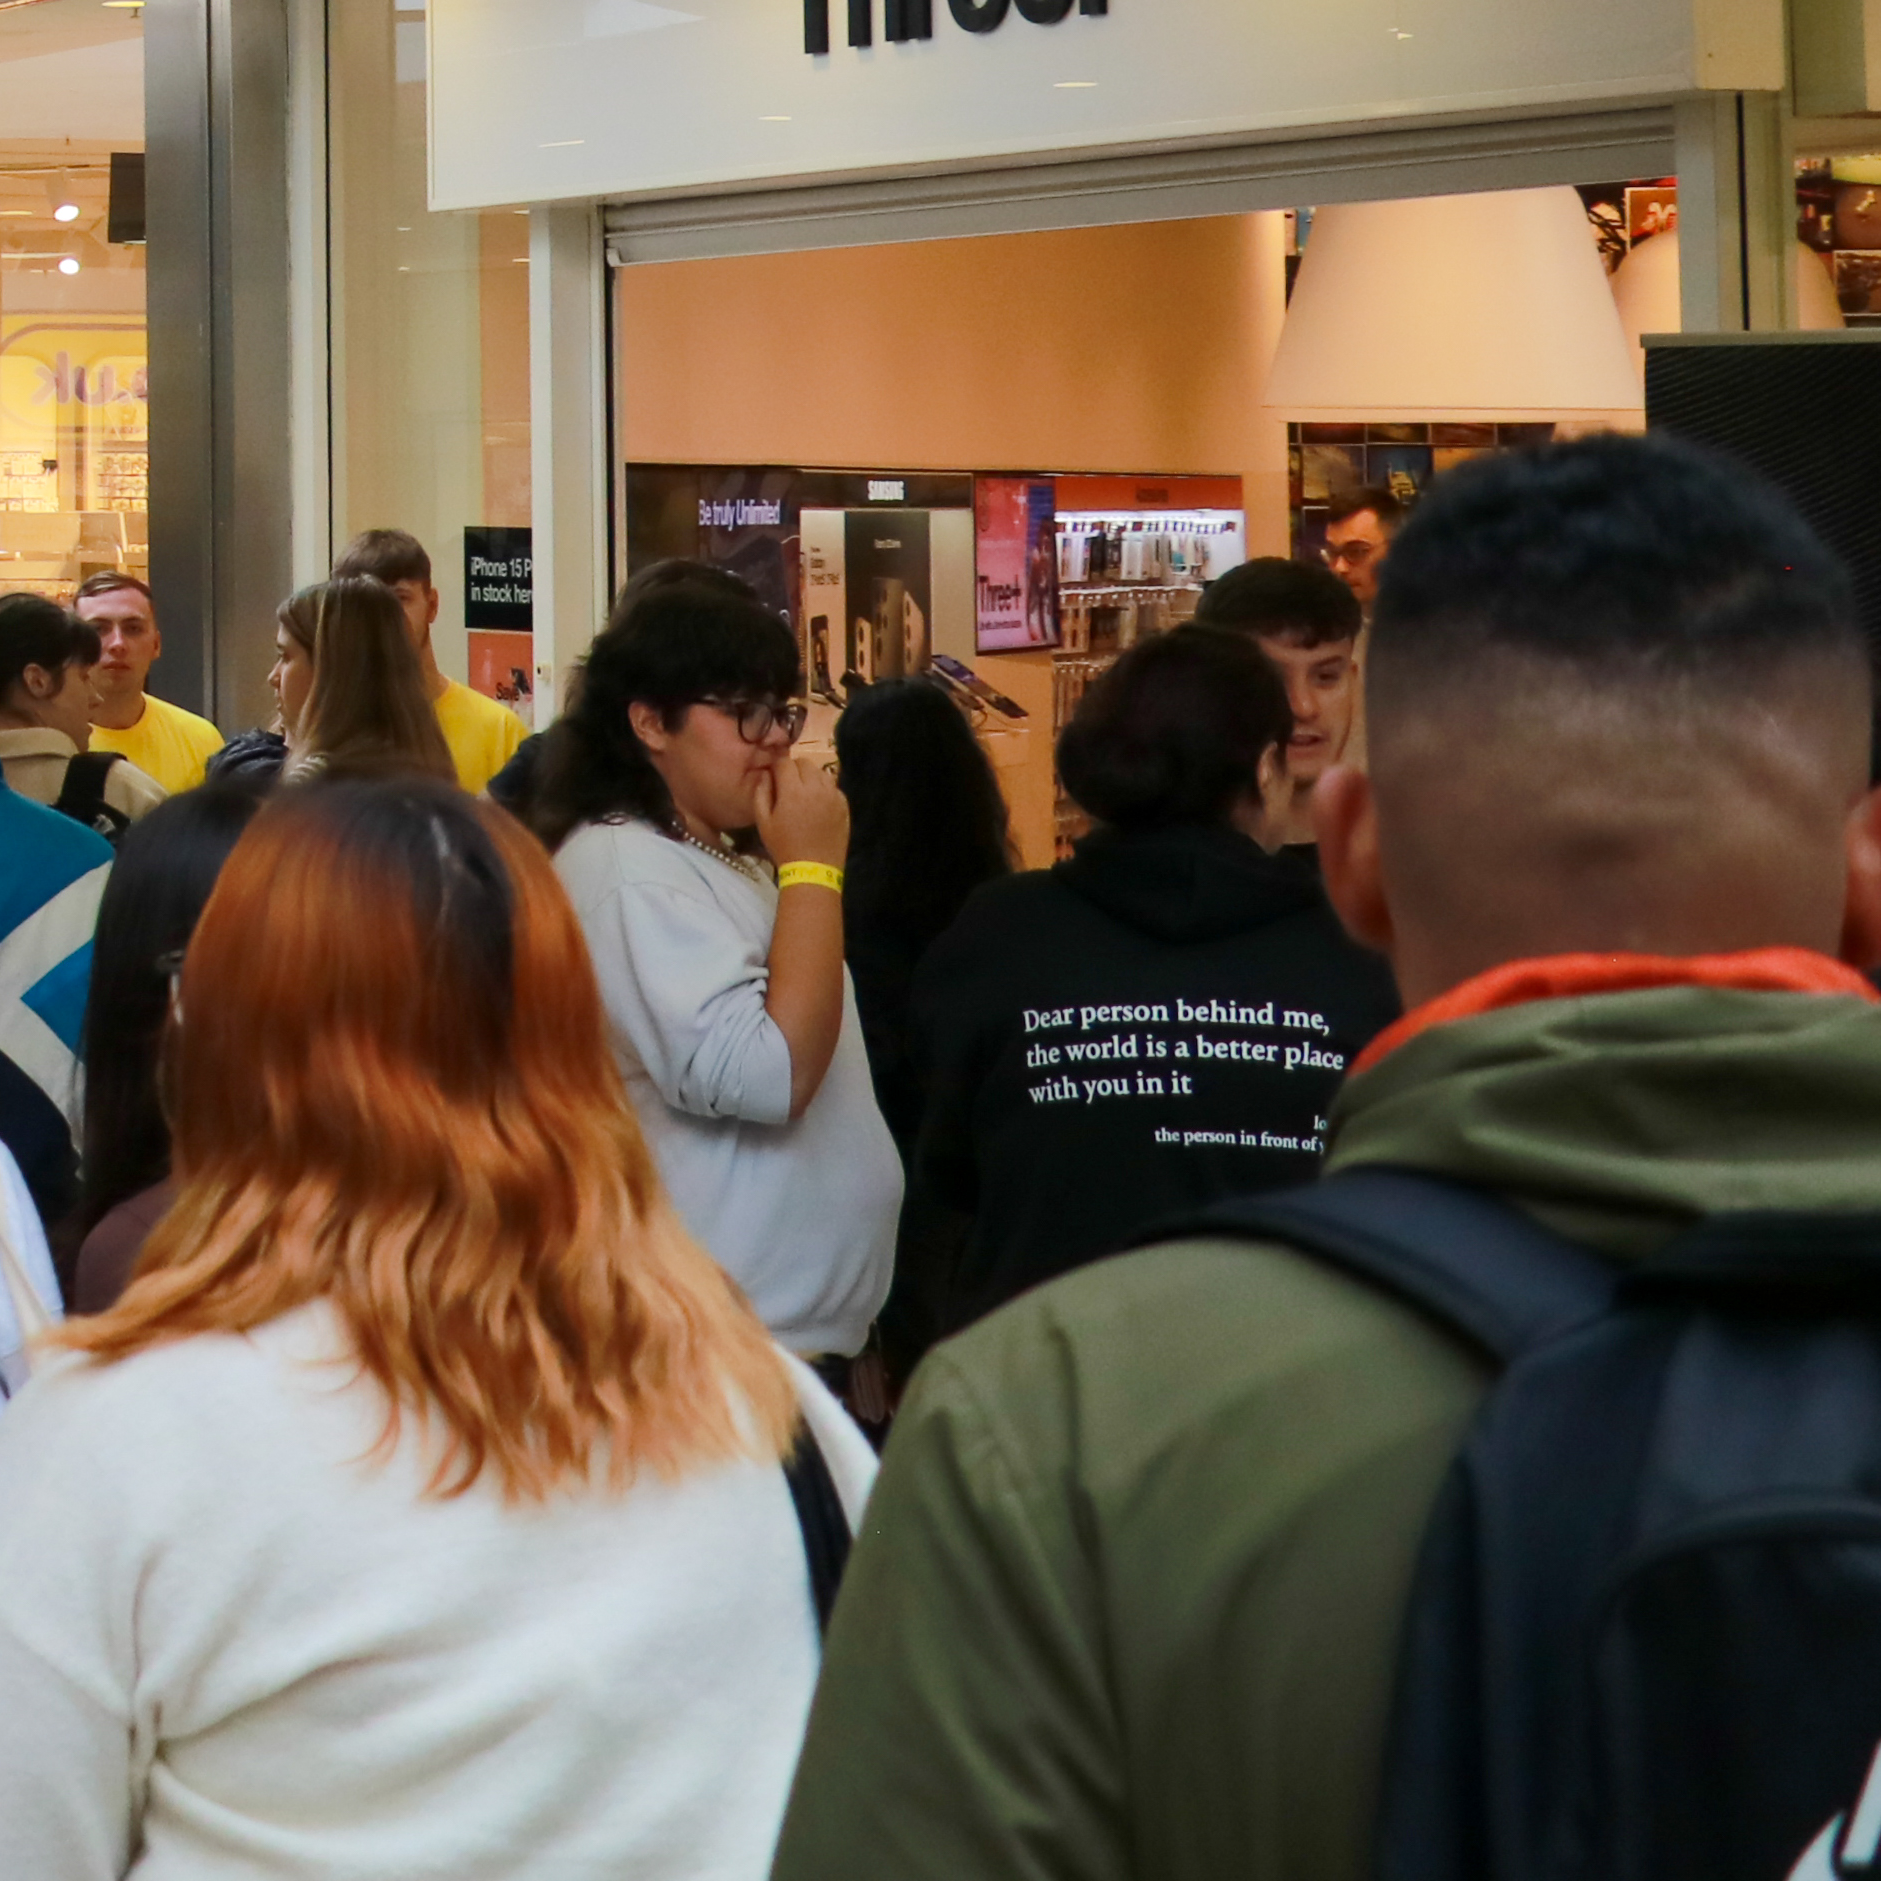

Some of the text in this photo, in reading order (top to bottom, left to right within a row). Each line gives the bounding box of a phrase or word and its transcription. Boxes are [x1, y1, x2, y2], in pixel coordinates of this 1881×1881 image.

[698, 499, 712, 526] Be
[737, 499, 780, 526] Unlimited
[470, 556, 508, 578] iPhone
[509, 558, 523, 578] 15
[470, 582, 533, 603] in stock her
[1023, 999, 1330, 1036] Dear person behind me,
[1026, 1034, 1345, 1070] the world is a better place
[1028, 1070, 1193, 1104] with you in it
[1154, 1126, 1180, 1143] the
[1183, 1129, 1236, 1146] person
[1240, 1130, 1257, 1146] in
[1260, 1131, 1298, 1150] front
[1301, 1137, 1318, 1152] of
